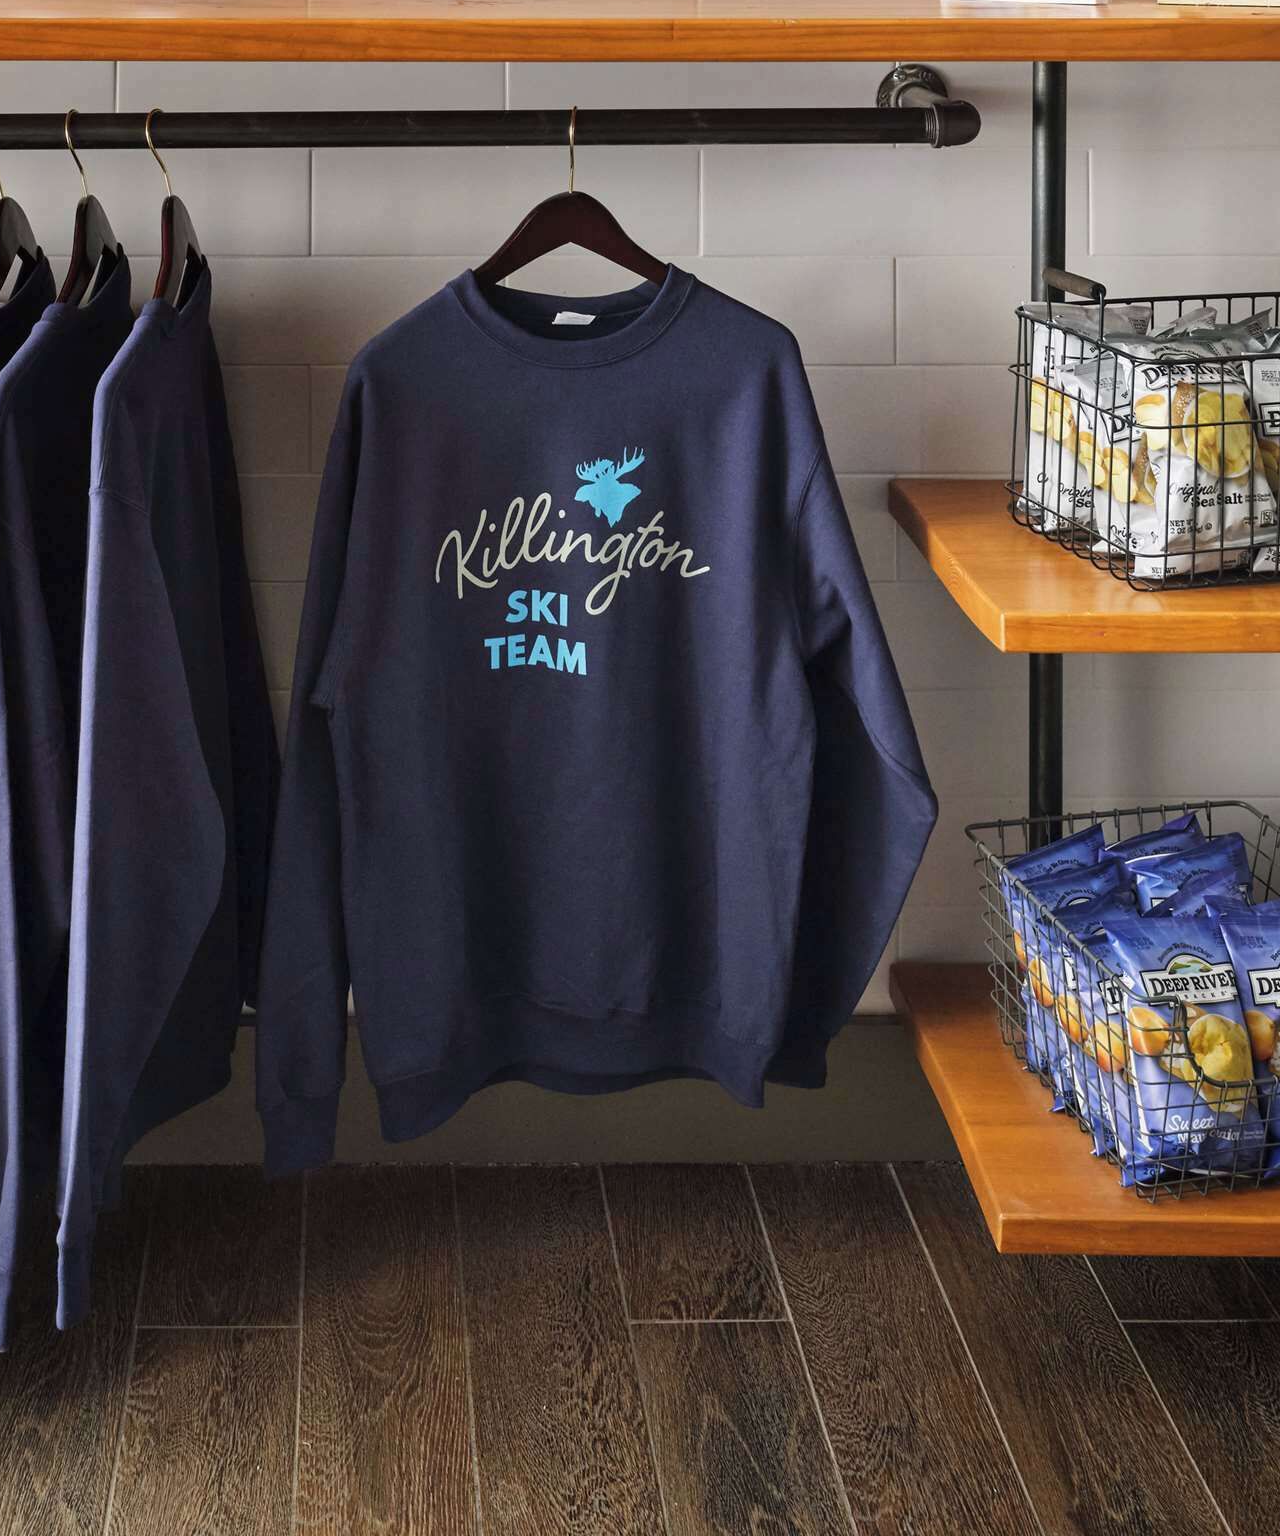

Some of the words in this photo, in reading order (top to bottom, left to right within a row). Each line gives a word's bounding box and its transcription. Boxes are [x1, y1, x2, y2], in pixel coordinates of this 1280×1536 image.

[1141, 364, 1186, 385] DEEP
[1190, 496, 1216, 508] Sea
[1217, 493, 1244, 506] Salt
[435, 491, 711, 616] Killington
[504, 588, 569, 628] SKI
[483, 633, 588, 676] TEAM
[1148, 975, 1190, 997] DEEP
